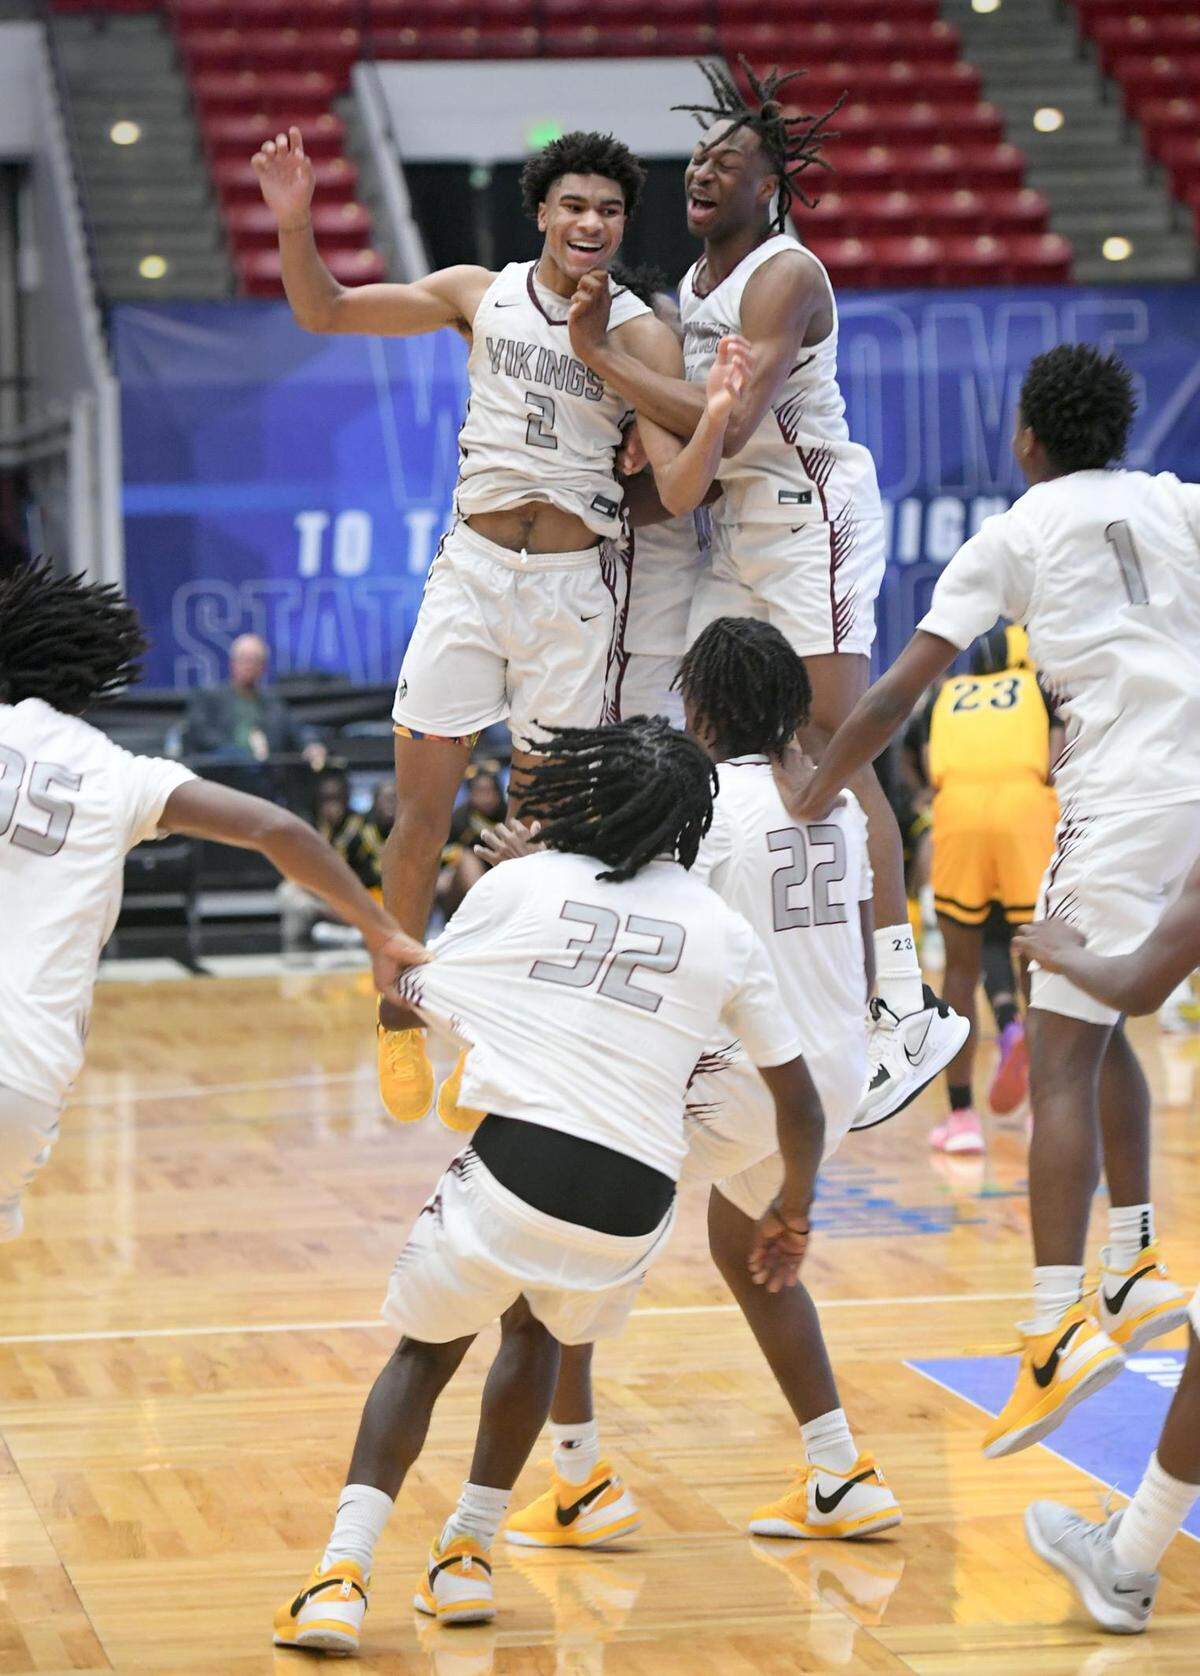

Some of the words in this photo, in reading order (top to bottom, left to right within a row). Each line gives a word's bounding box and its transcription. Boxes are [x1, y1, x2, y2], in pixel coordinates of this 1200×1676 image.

[486, 337, 604, 401] VIKINGS
[525, 391, 557, 450] 2
[294, 510, 373, 577] TO
[1104, 518, 1149, 606] 1
[953, 678, 1018, 712] 23
[766, 824, 848, 932] 22
[528, 900, 686, 1013] 32
[892, 937, 913, 951] 23
